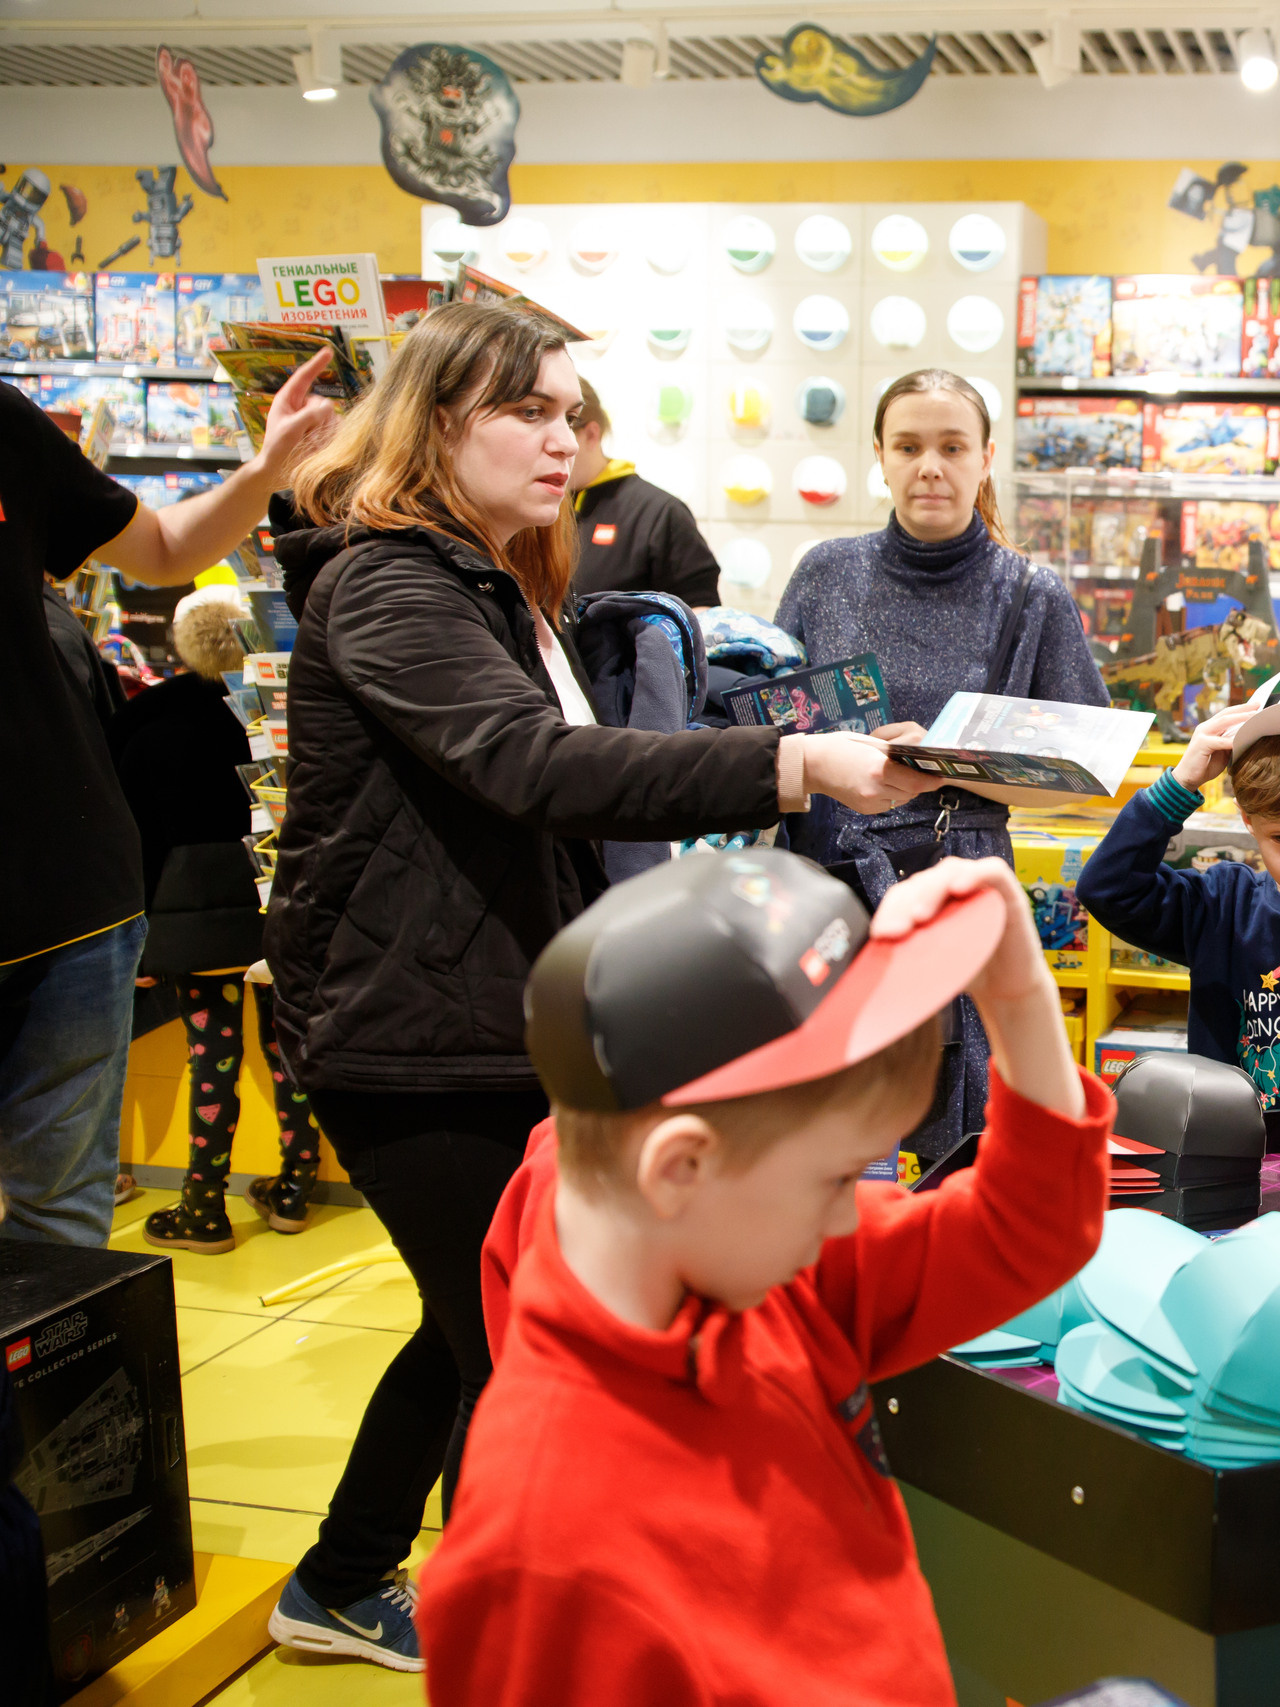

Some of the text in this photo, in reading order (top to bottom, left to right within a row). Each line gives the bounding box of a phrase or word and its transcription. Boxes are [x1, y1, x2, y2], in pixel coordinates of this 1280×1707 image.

[272, 262, 358, 277] ГЕНИАЛЬНЫЕ
[275, 277, 361, 308] LEGO
[281, 308, 368, 322] ИЗОБРЕТЕНИЯ
[1103, 1059, 1126, 1074] LEG
[40, 1311, 89, 1341] STAR
[34, 1325, 87, 1359] WARS
[8, 1345, 31, 1366] LEGO
[27, 1332, 119, 1384] COLLECTOR SERIES
